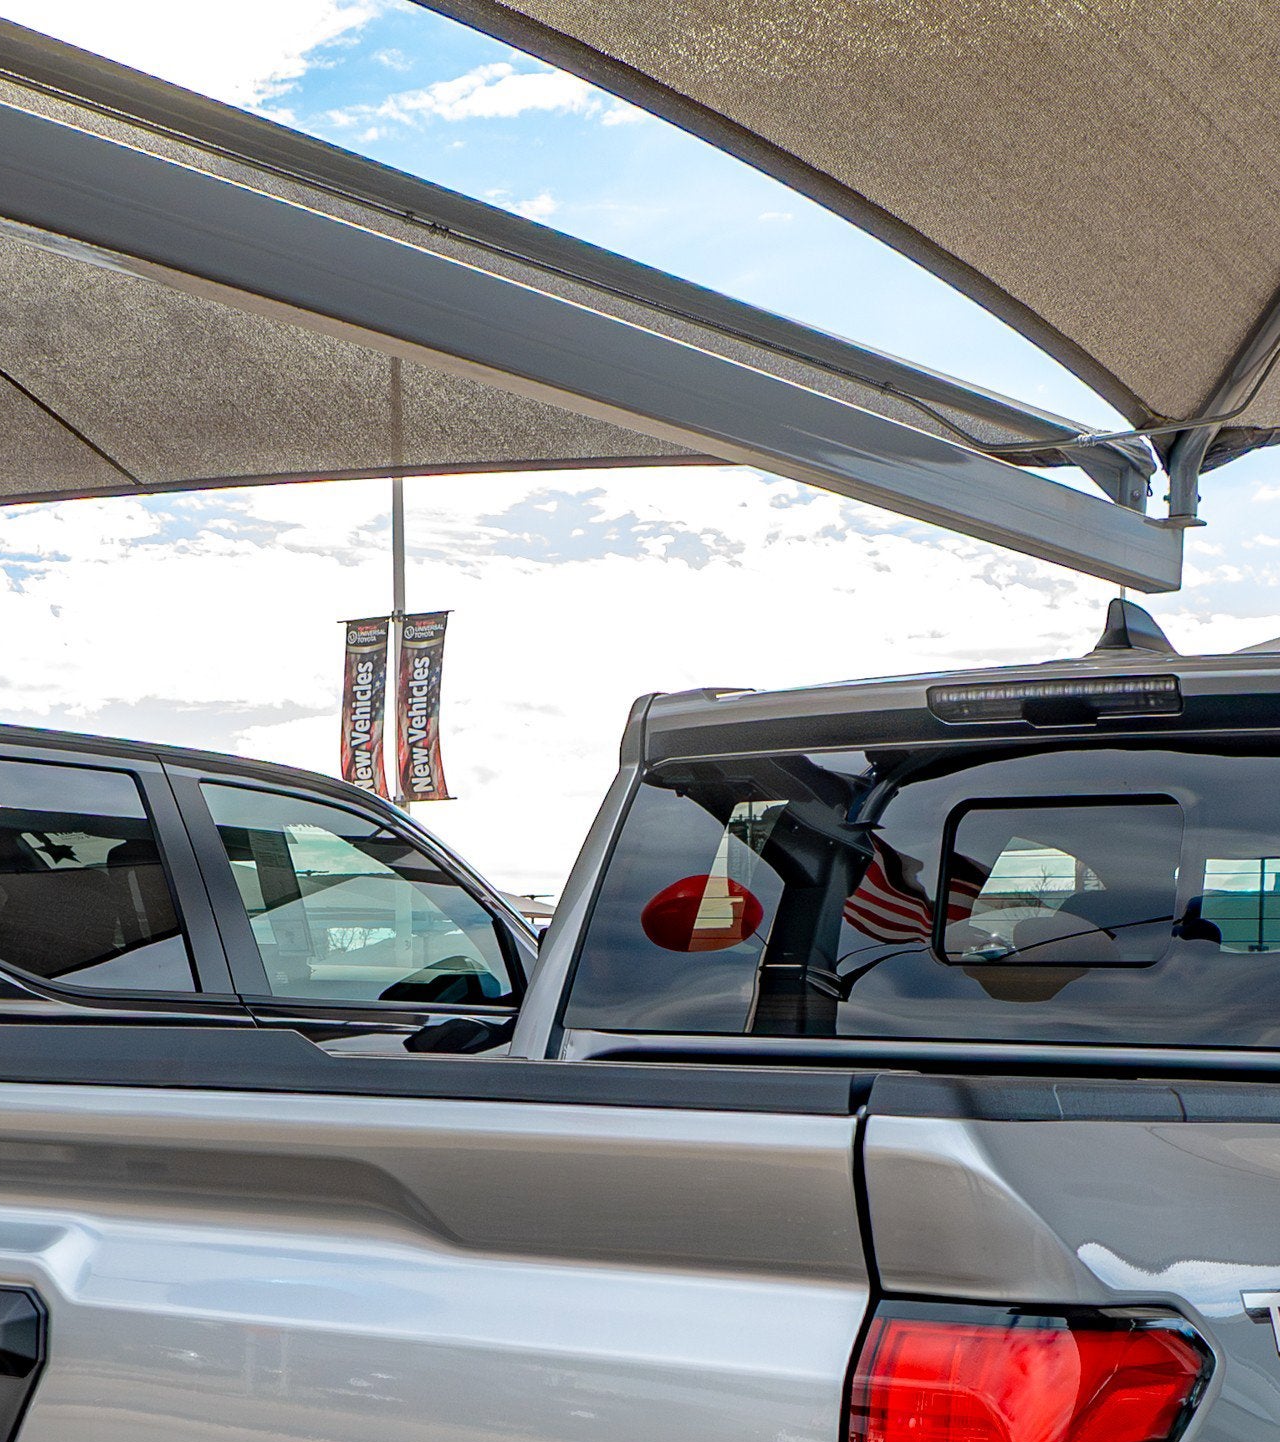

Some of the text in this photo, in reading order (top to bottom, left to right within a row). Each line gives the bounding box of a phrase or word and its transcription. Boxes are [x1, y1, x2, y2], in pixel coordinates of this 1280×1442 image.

[351, 661, 373, 746] Vehicles
[408, 656, 434, 793] New Vehicles
